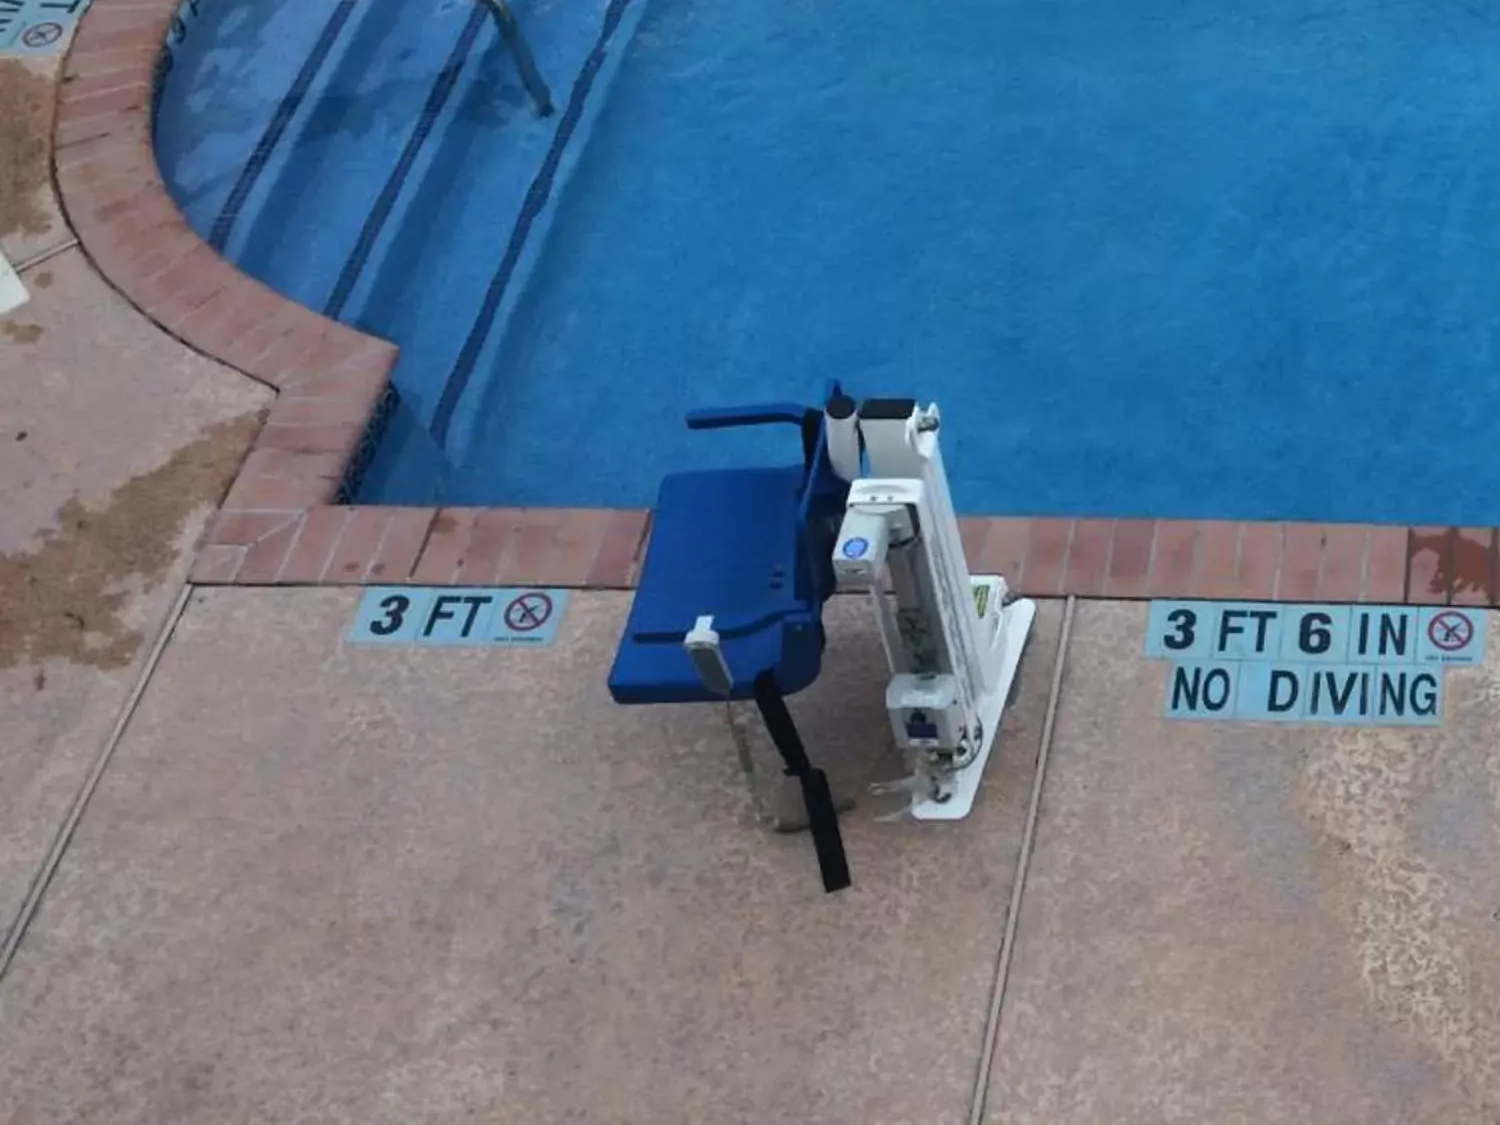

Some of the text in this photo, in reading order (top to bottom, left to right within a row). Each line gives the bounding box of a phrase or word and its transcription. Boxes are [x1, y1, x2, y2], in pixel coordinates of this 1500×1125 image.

[369, 594, 493, 638] 3 FT
[1163, 609, 1408, 656] 3 FT 6 IN
[1171, 667, 1438, 716] NO DIVING
